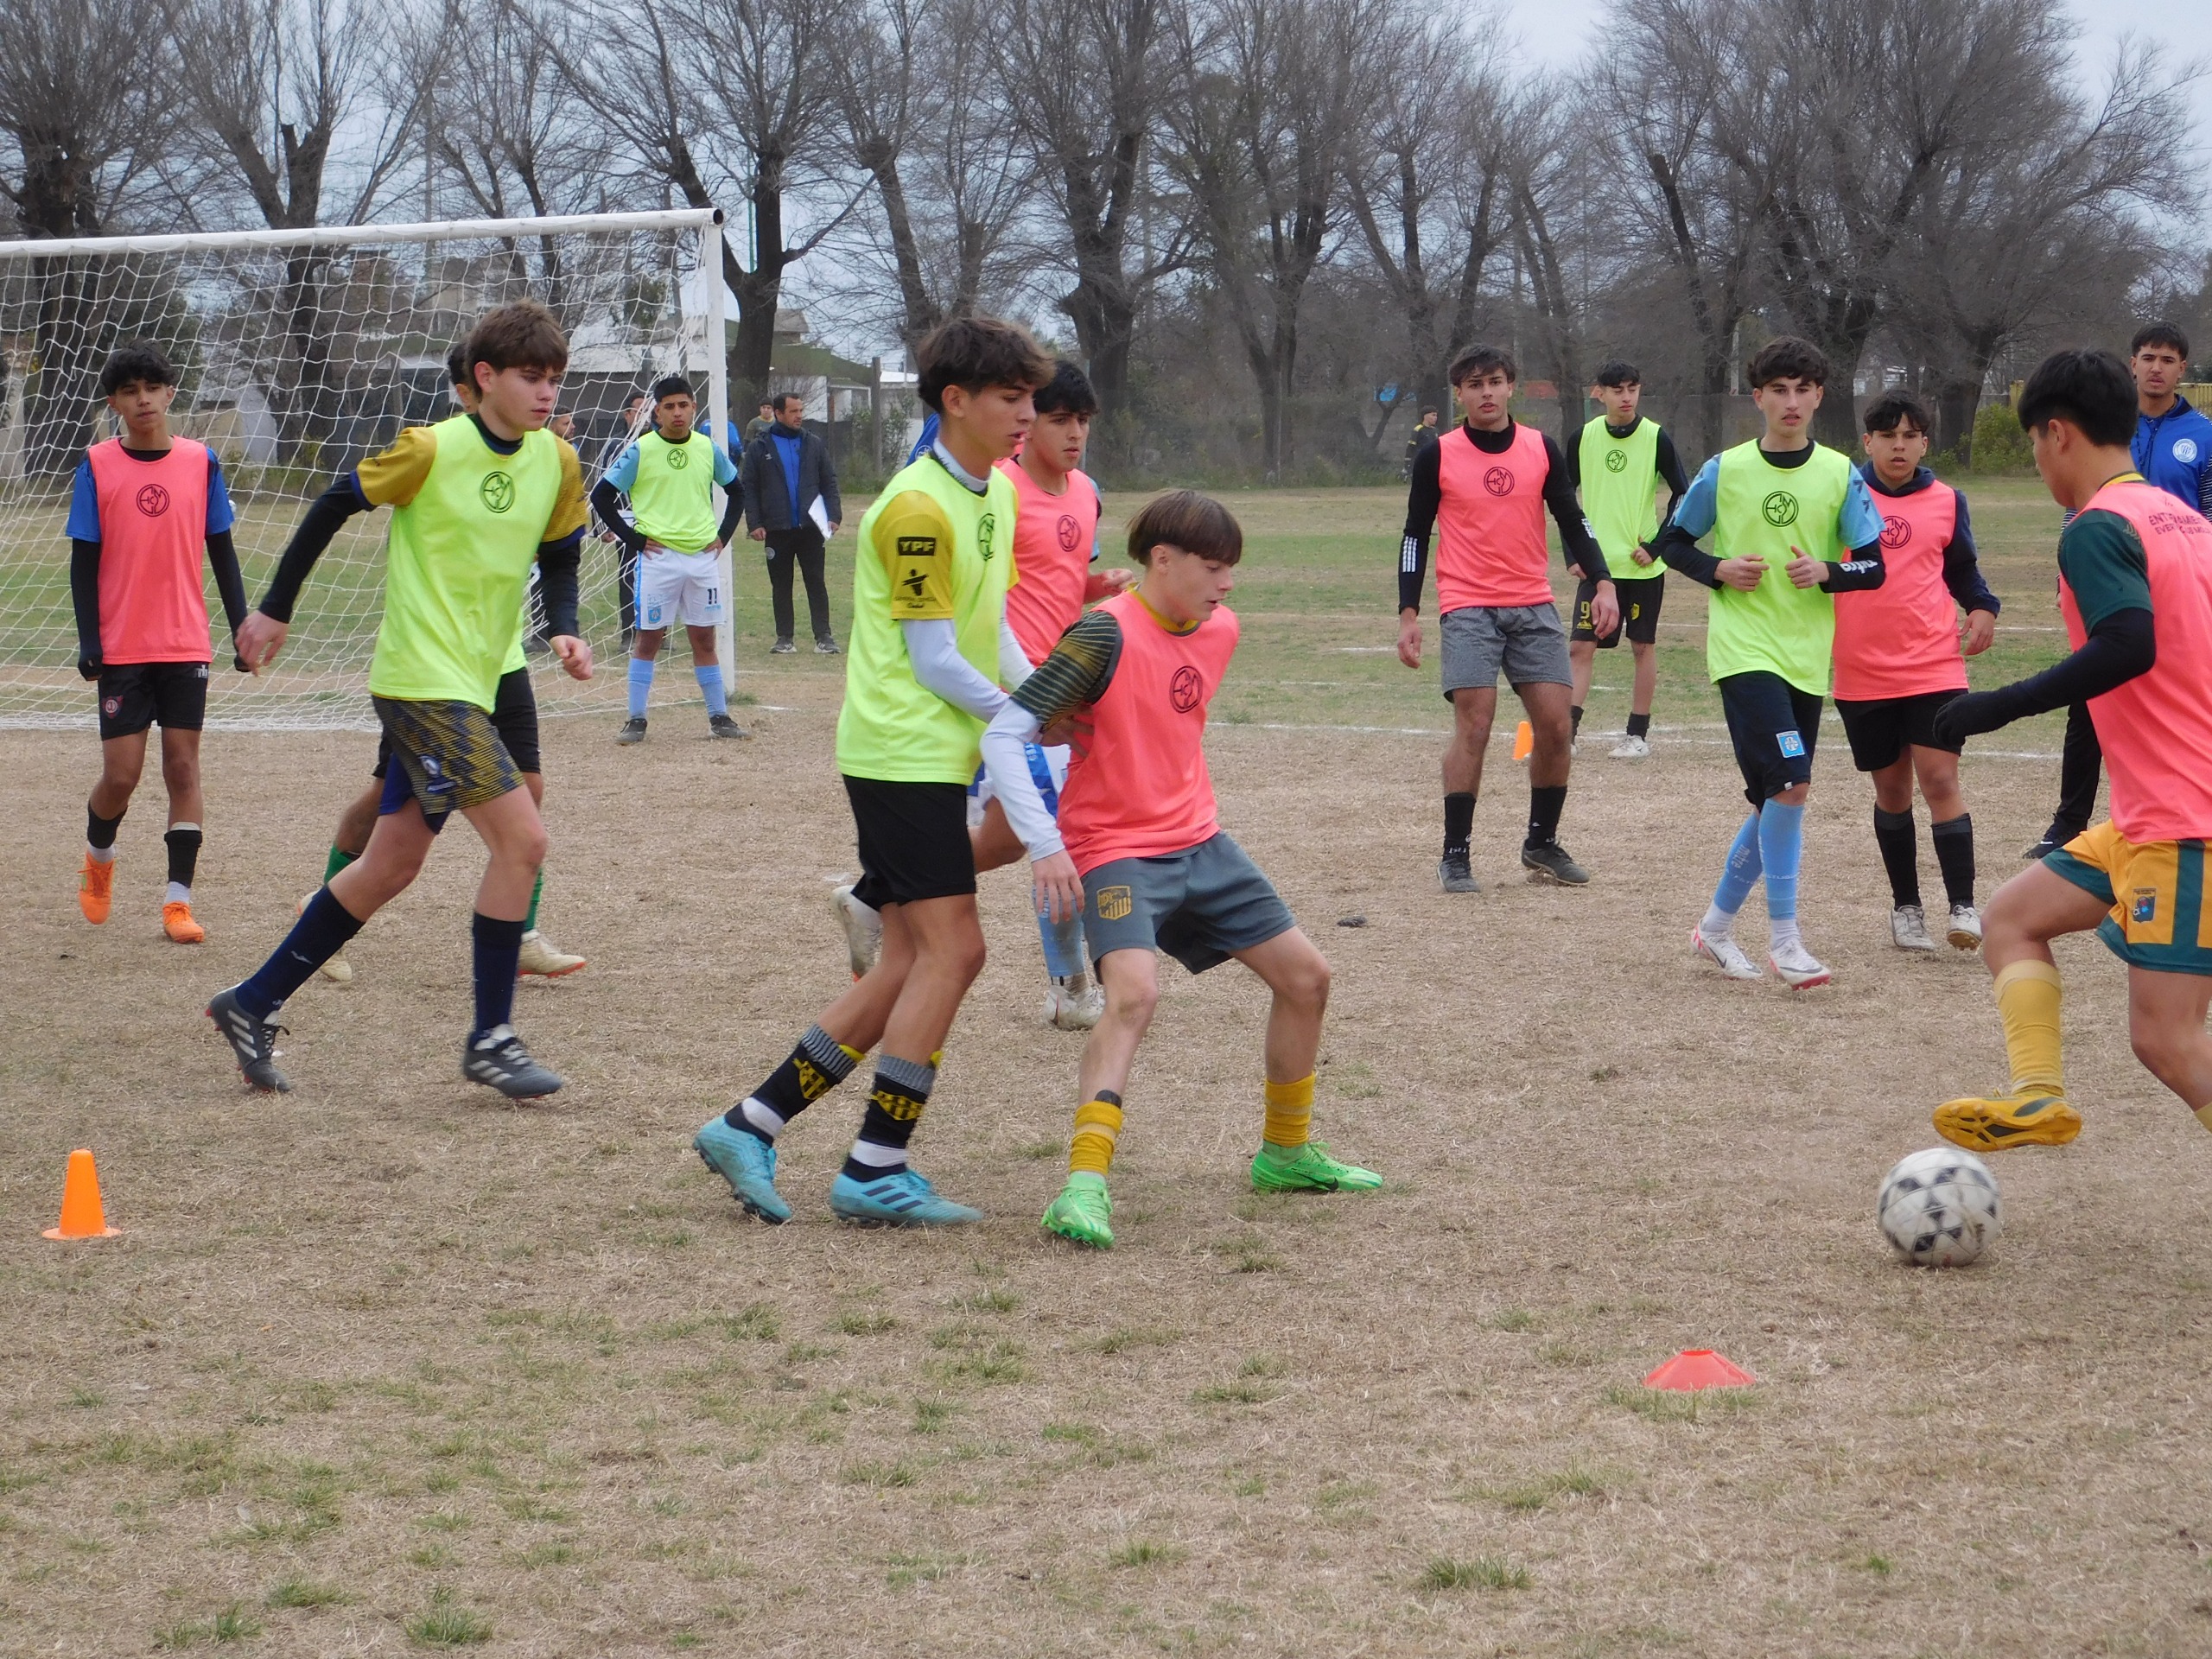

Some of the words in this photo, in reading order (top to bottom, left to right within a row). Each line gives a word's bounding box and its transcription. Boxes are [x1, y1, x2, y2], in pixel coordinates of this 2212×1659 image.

[899, 541, 935, 552] YPF
[707, 588, 718, 605] 11
[1580, 601, 1591, 620] 9
